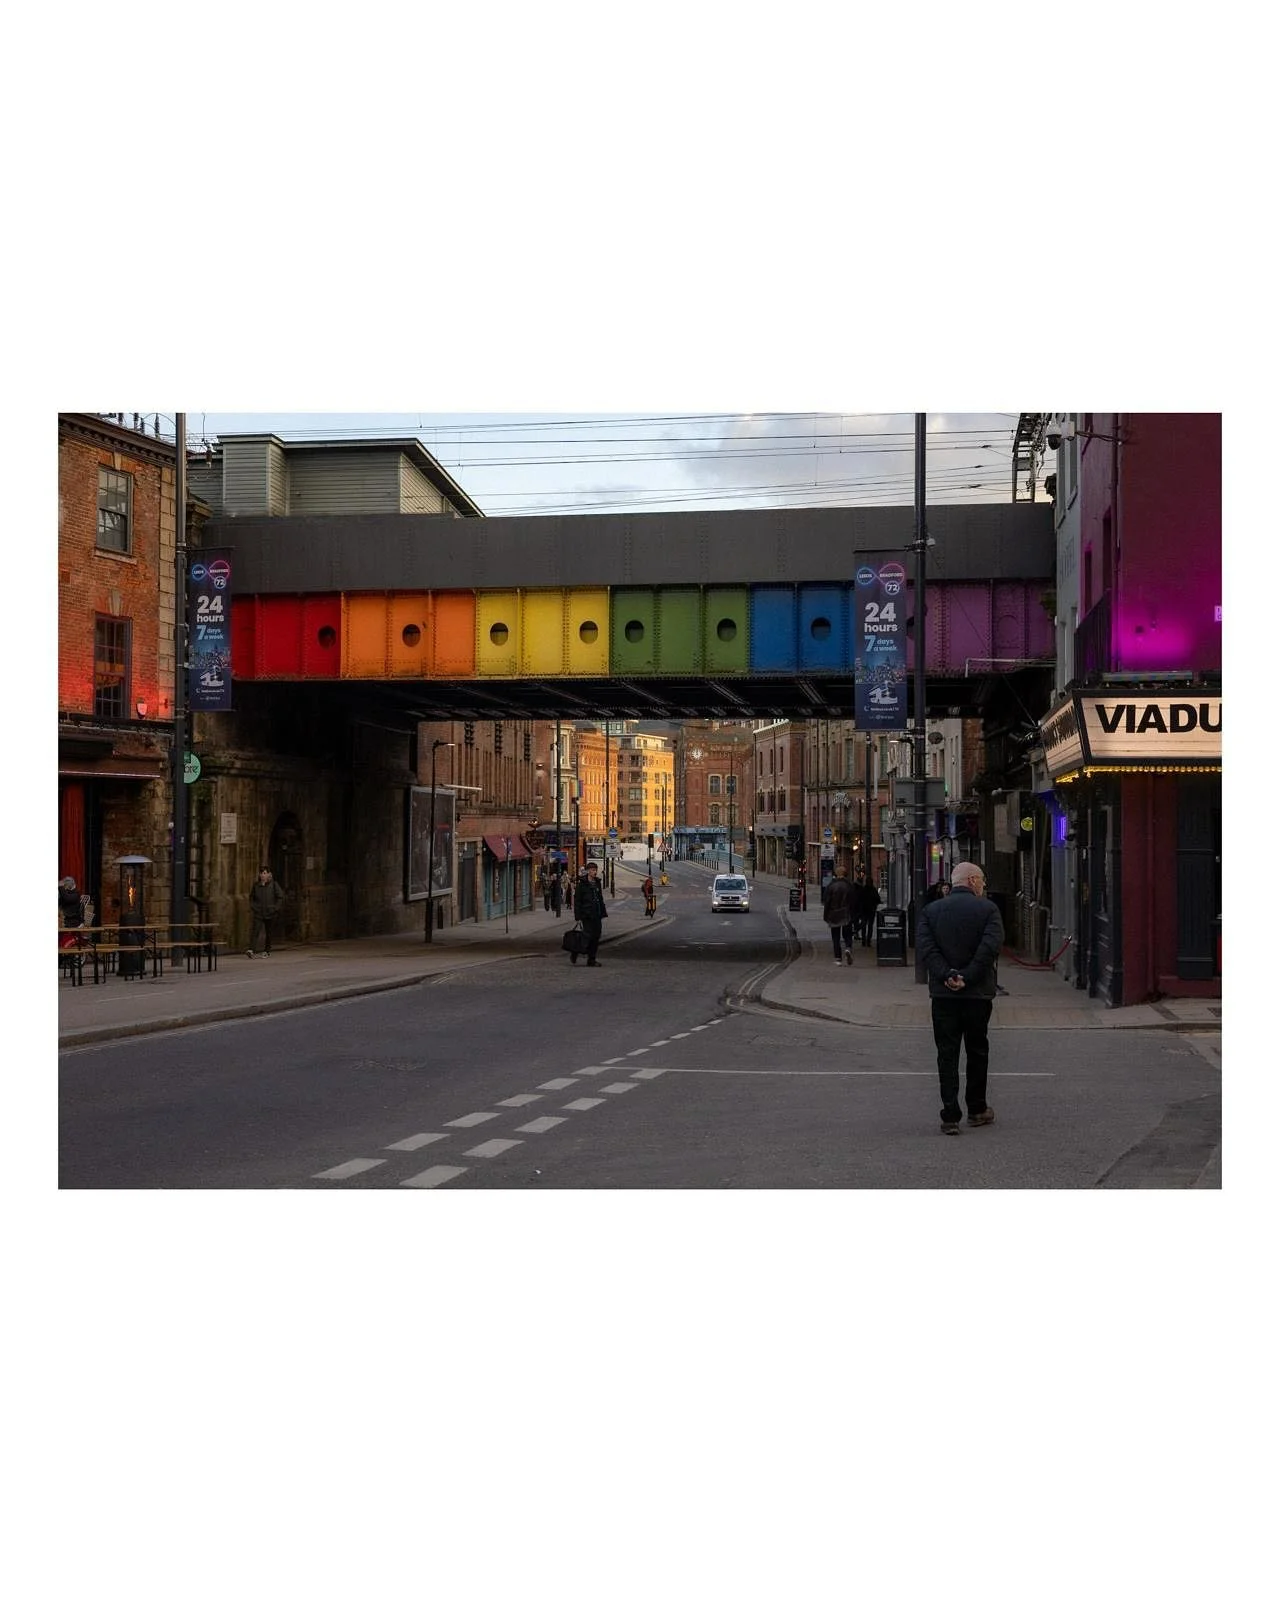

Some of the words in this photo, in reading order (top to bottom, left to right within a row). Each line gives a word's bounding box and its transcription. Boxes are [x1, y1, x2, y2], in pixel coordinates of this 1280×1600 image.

[198, 595, 223, 614] 24
[865, 602, 896, 622] 24
[197, 614, 224, 622] hours
[197, 625, 206, 640] 7
[864, 623, 898, 633] hours
[864, 635, 876, 652] 7
[1095, 704, 1222, 733] VIADU
